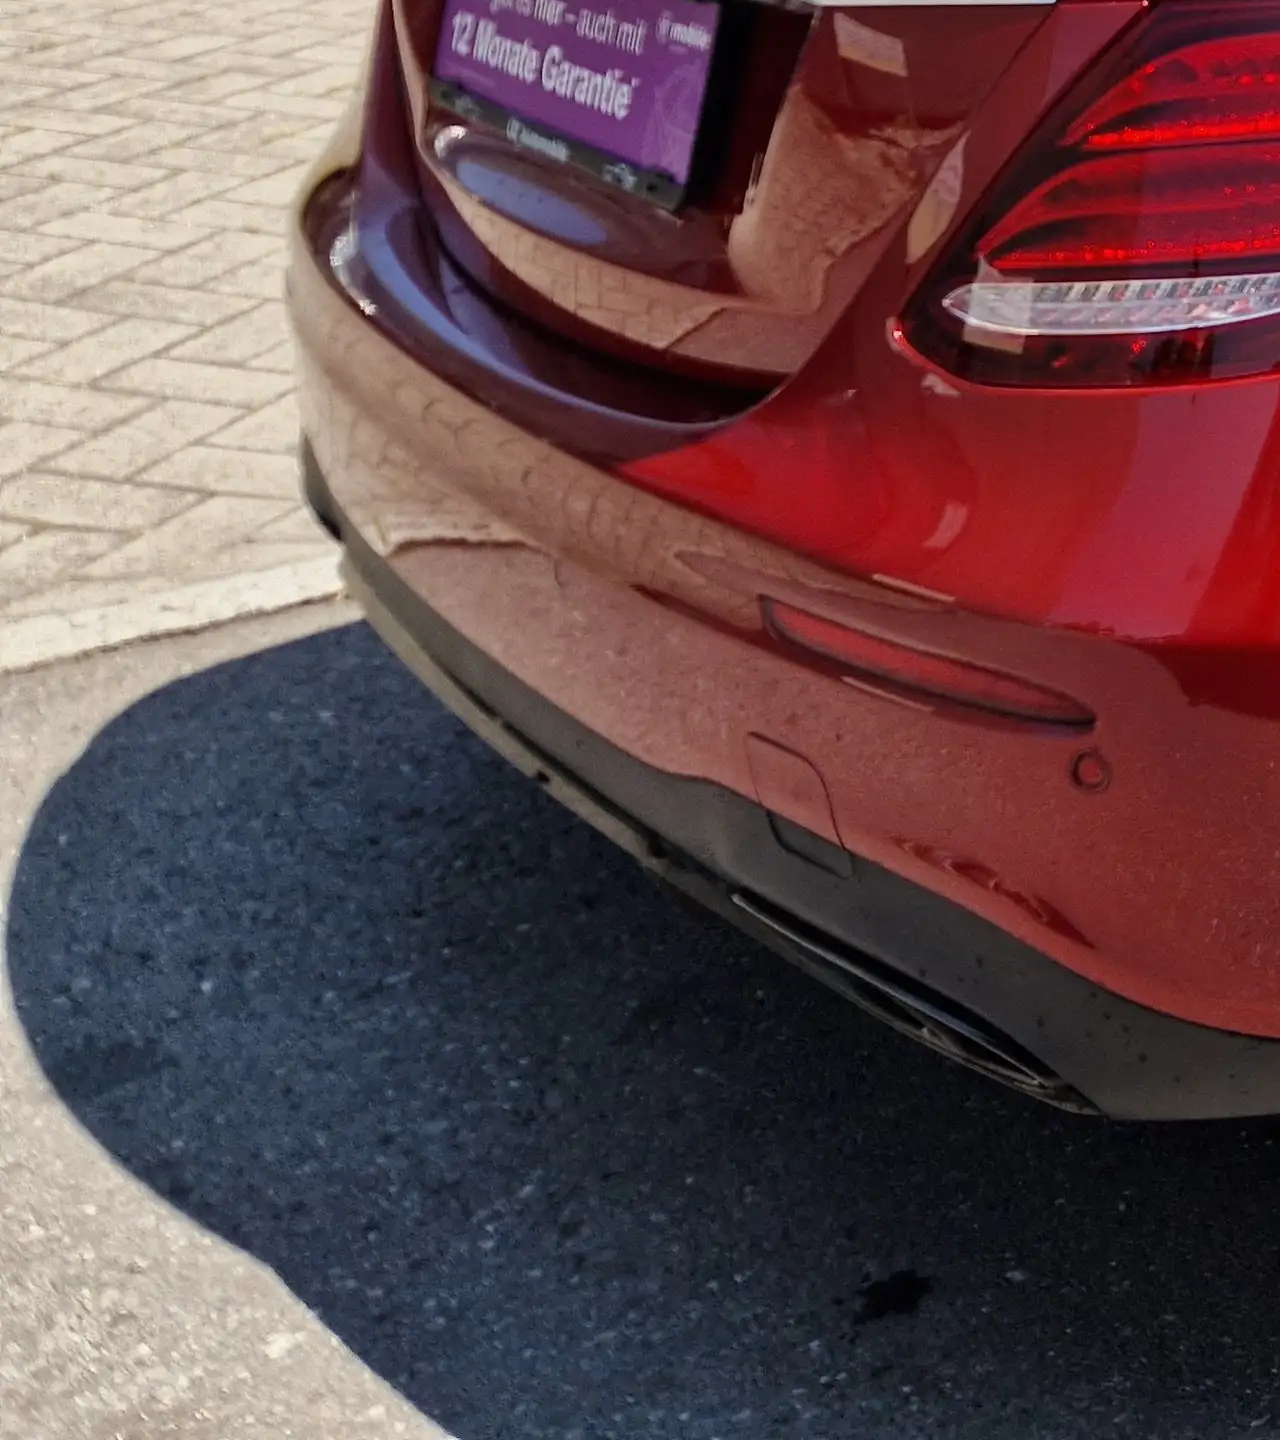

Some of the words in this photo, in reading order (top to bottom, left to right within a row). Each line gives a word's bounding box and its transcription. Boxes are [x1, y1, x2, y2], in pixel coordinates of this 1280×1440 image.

[452, 10, 476, 57] 12
[473, 17, 541, 85] Monate
[576, 9, 617, 45] auch
[616, 17, 648, 56] mit
